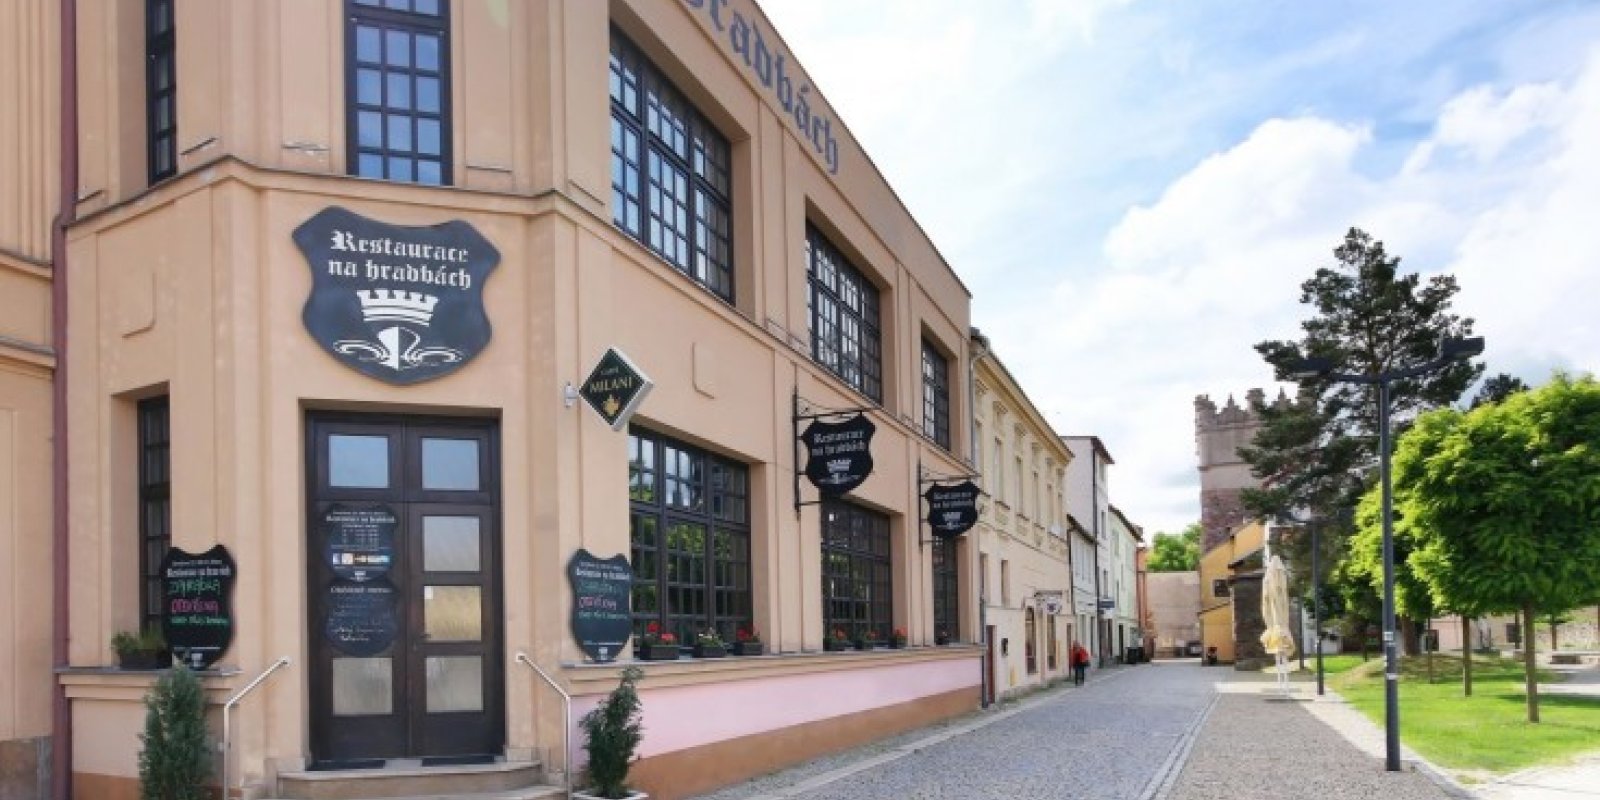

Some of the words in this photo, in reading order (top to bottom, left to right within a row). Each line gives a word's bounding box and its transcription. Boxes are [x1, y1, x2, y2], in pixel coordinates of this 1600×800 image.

[686, 0, 839, 175] radbách
[330, 229, 469, 263] Restaurace
[328, 259, 358, 278] na
[365, 259, 471, 290] hradbách
[590, 376, 632, 393] MILANI
[813, 430, 864, 445] Restaurace
